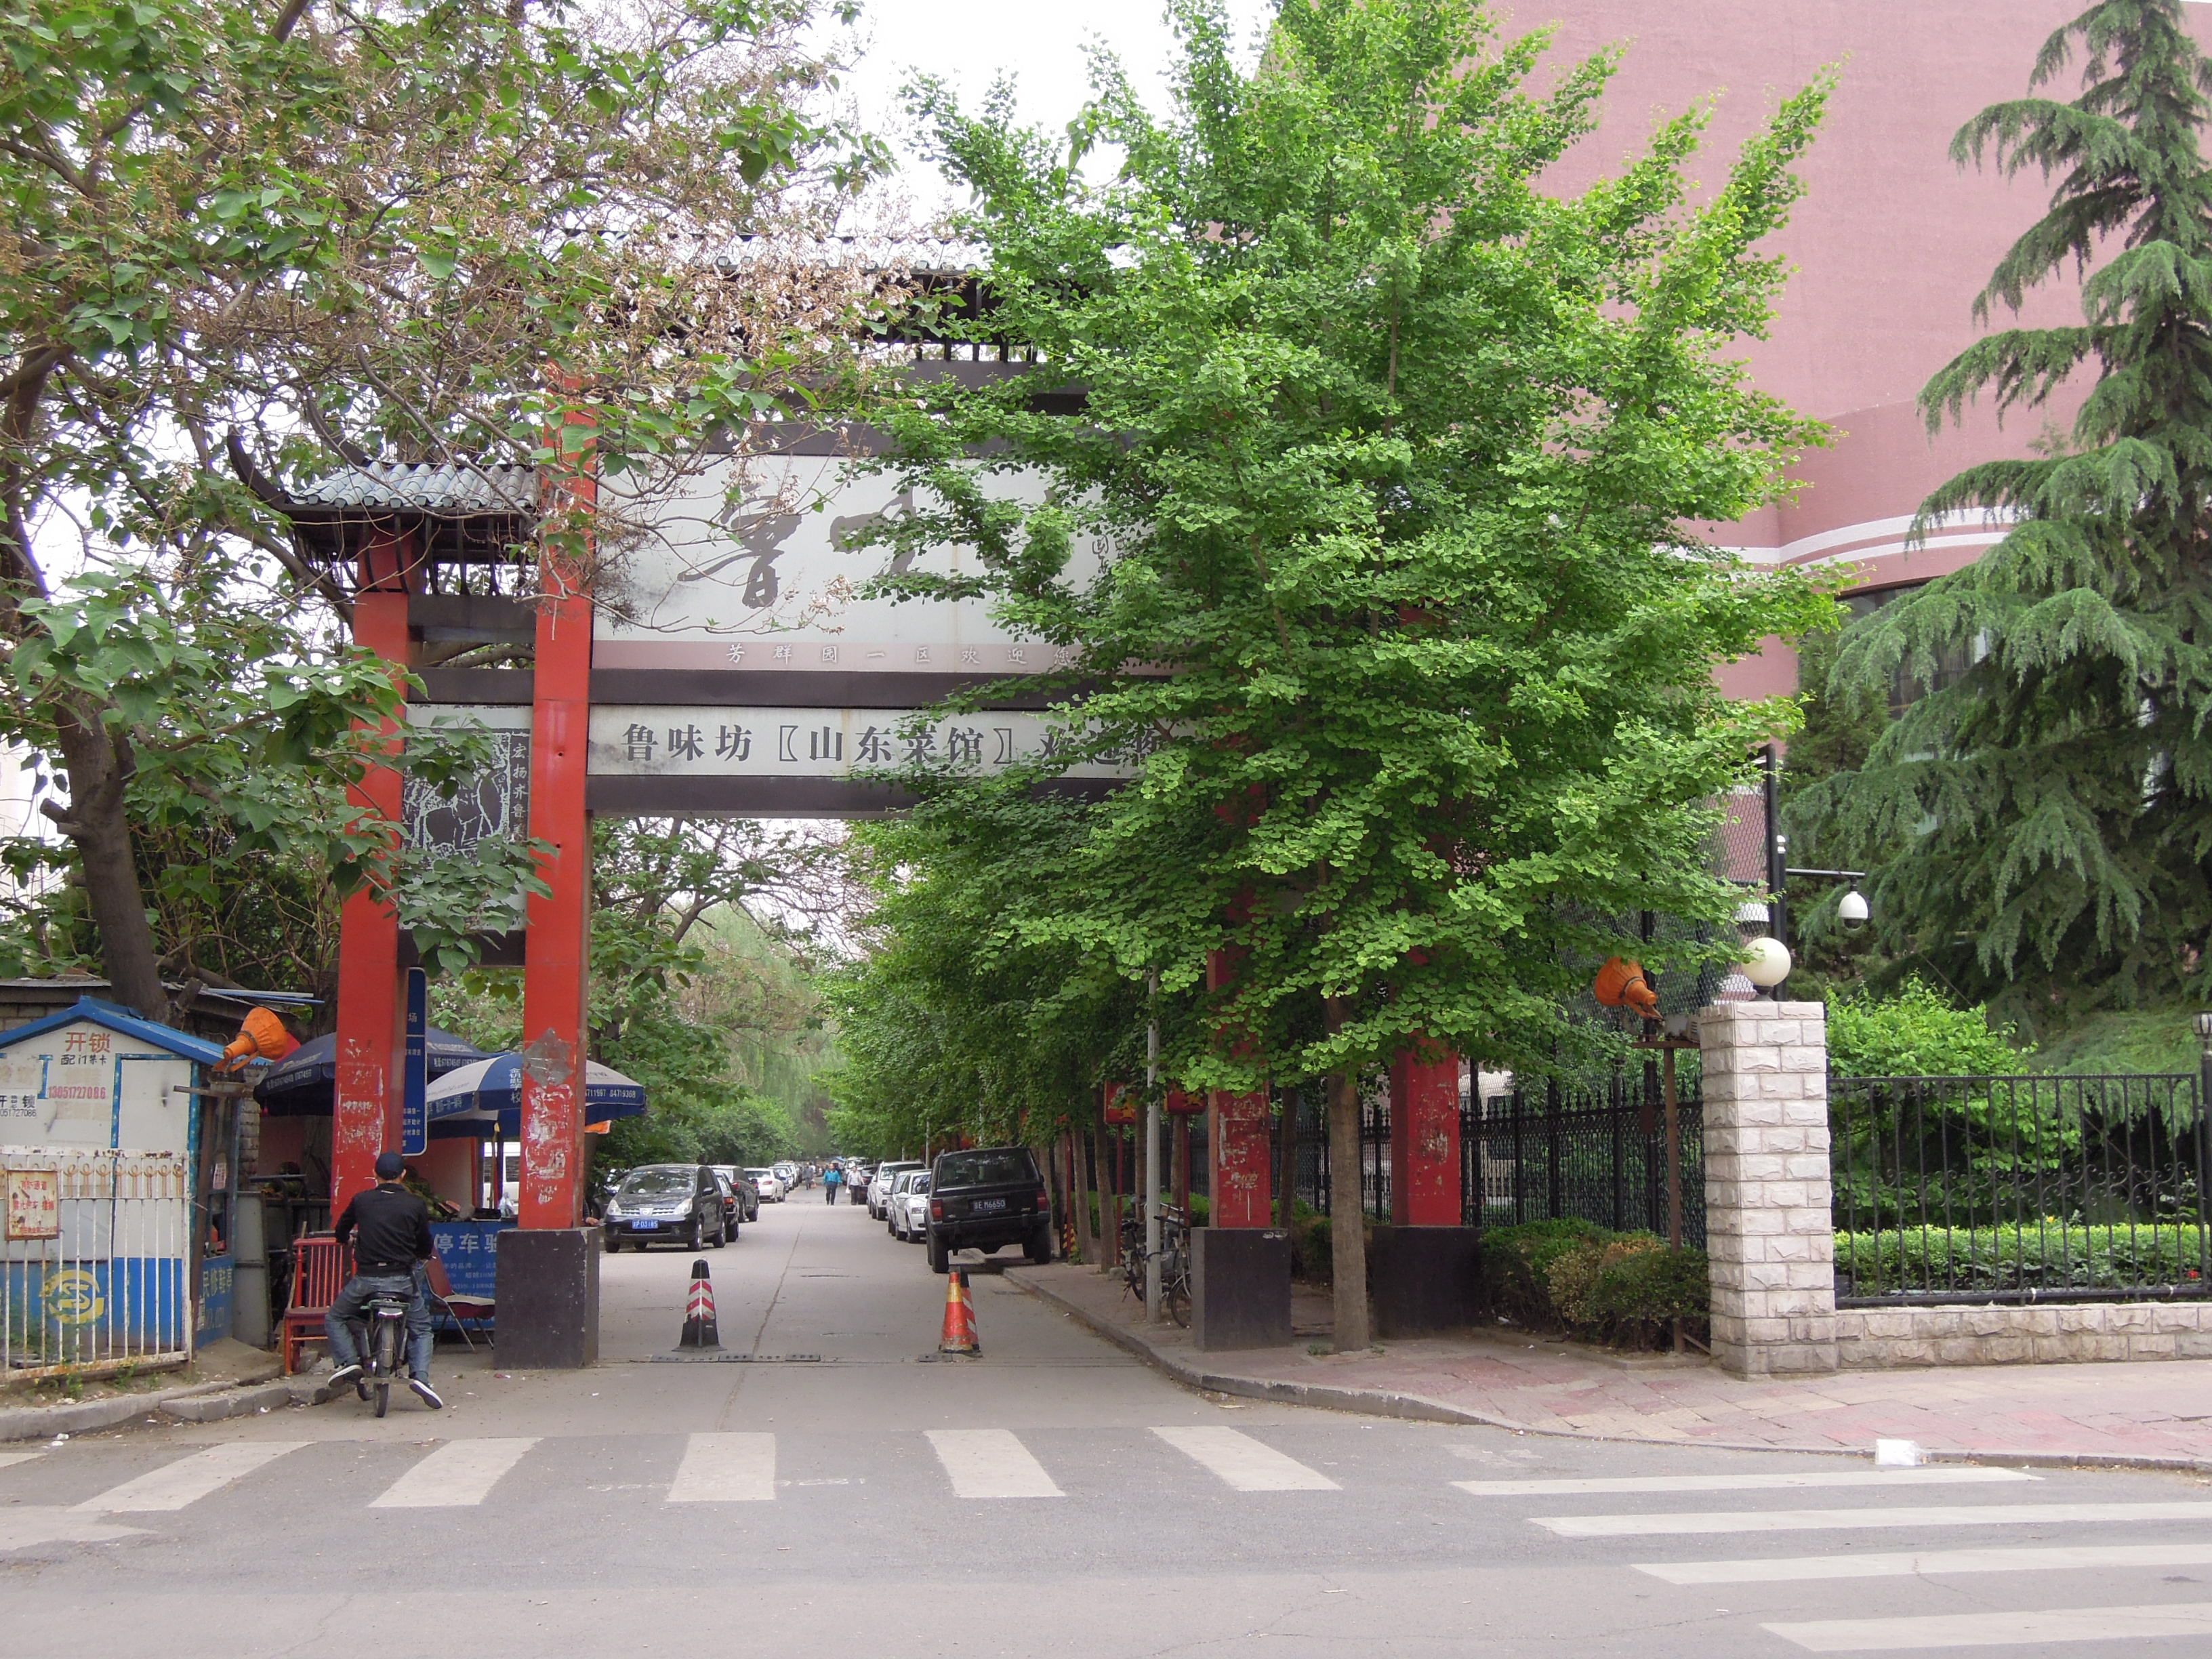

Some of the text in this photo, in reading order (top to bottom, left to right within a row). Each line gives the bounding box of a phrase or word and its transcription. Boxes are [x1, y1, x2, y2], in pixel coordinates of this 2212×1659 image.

[726, 644, 1072, 665] 芳群园一区欢迎您
[65, 1032, 110, 1052] 开锁
[61, 1054, 108, 1065] 配门禁卡
[49, 1086, 106, 1099] 13051727086
